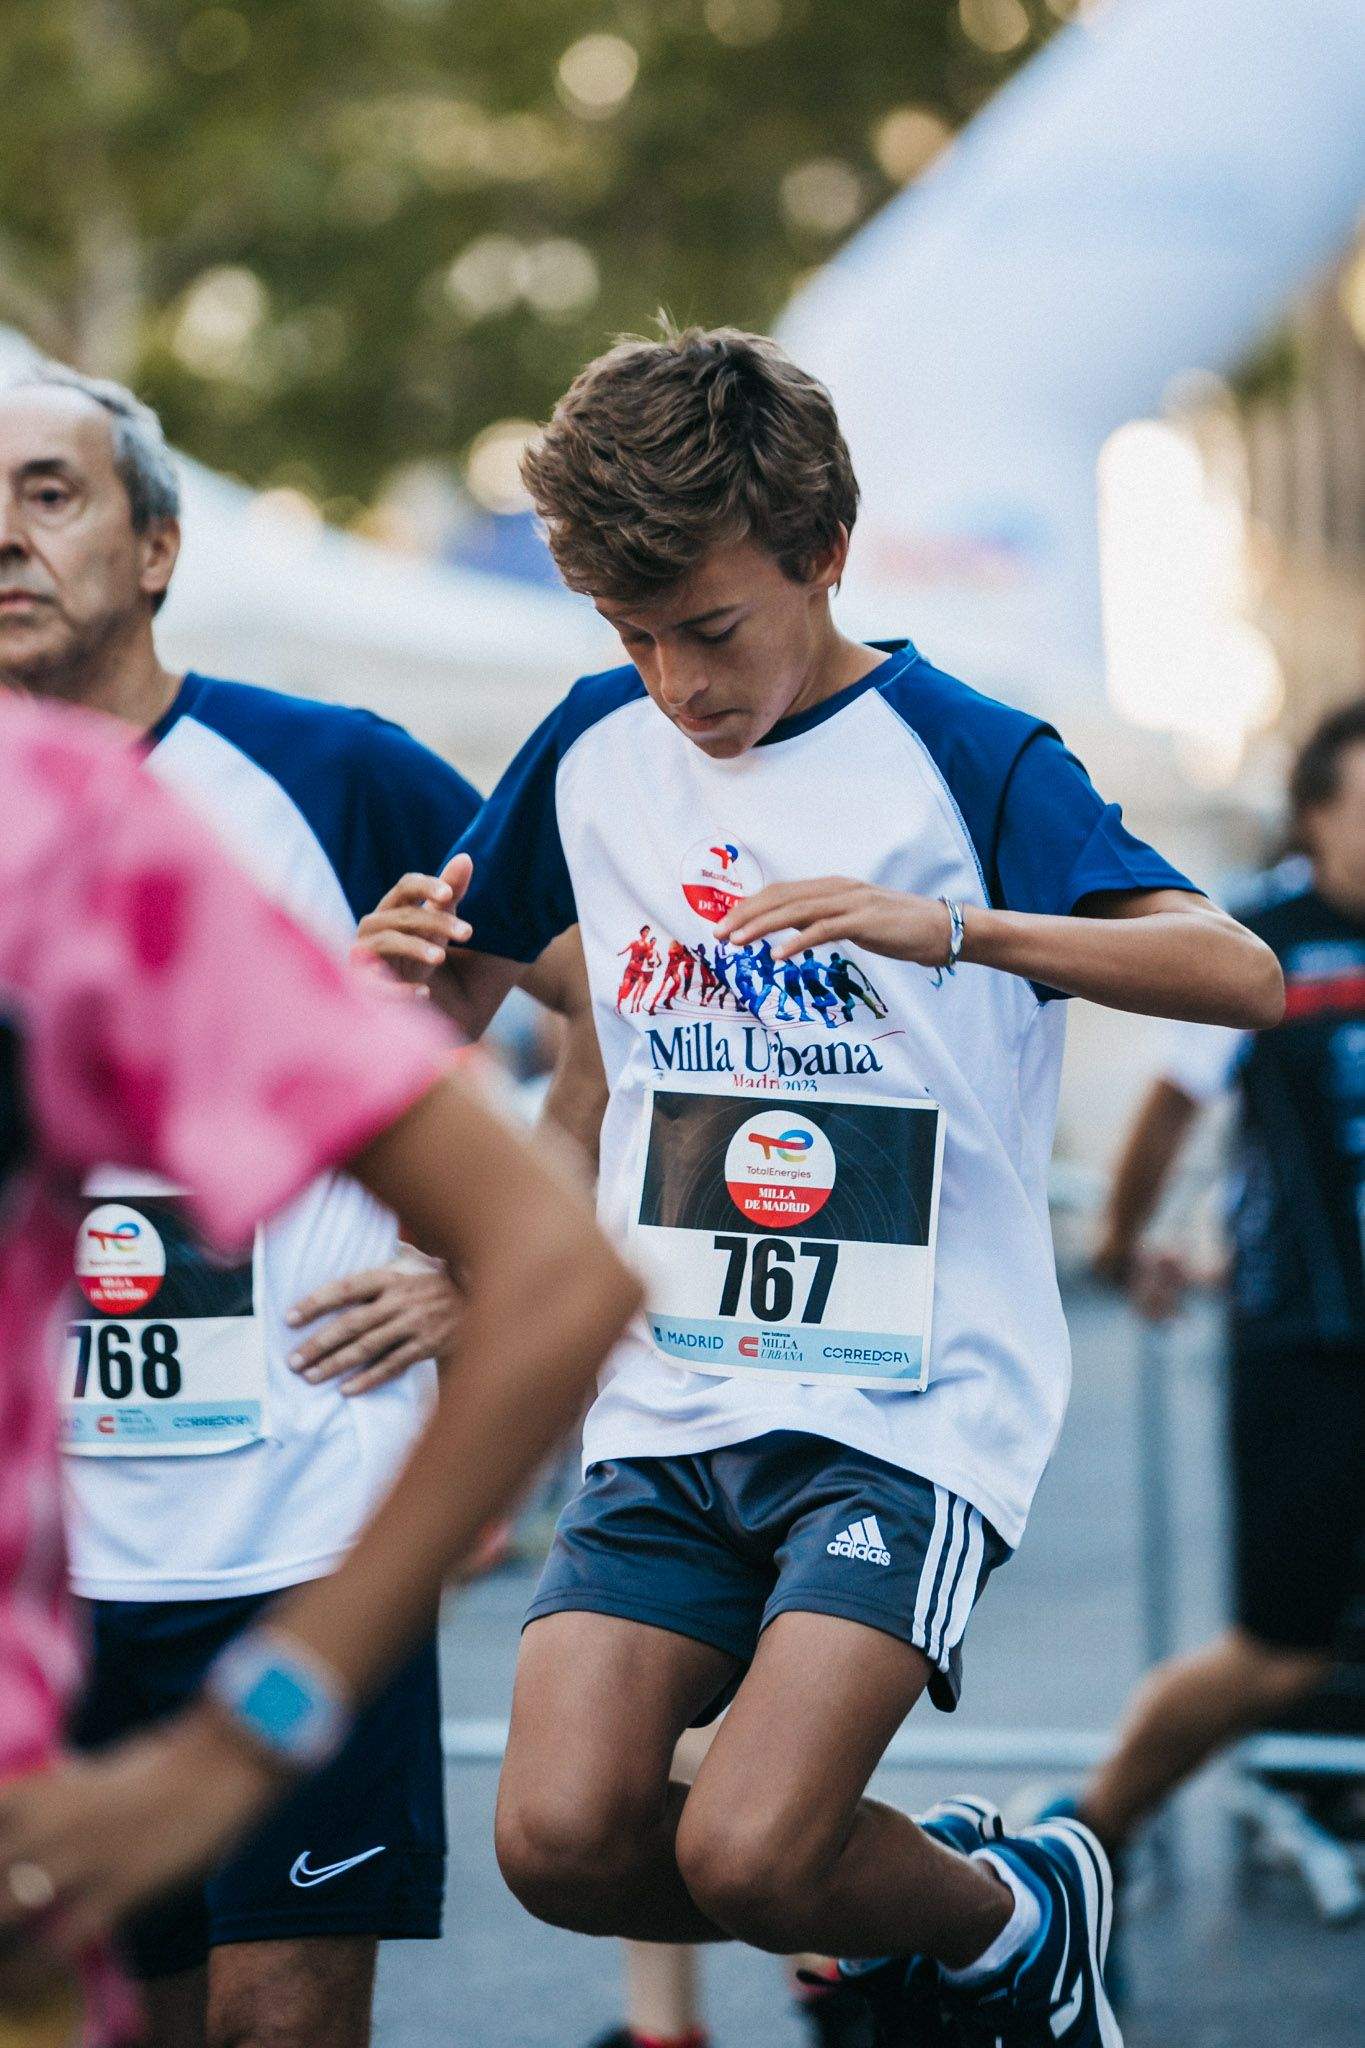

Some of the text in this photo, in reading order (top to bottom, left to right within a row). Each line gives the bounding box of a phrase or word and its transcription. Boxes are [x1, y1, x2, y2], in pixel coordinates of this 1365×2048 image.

[645, 1022, 883, 1078] Milla Urbana
[746, 1165, 812, 1180] TotalEnergies
[758, 1187, 796, 1200] MILLA
[744, 1198, 811, 1213] DE MADRID
[714, 1235, 839, 1324] 767
[667, 1331, 724, 1350] MADRID
[762, 1337, 798, 1350] MILLA
[66, 1324, 182, 1400] 768
[761, 1348, 804, 1362] URBANA
[826, 1540, 892, 1567] adidas
